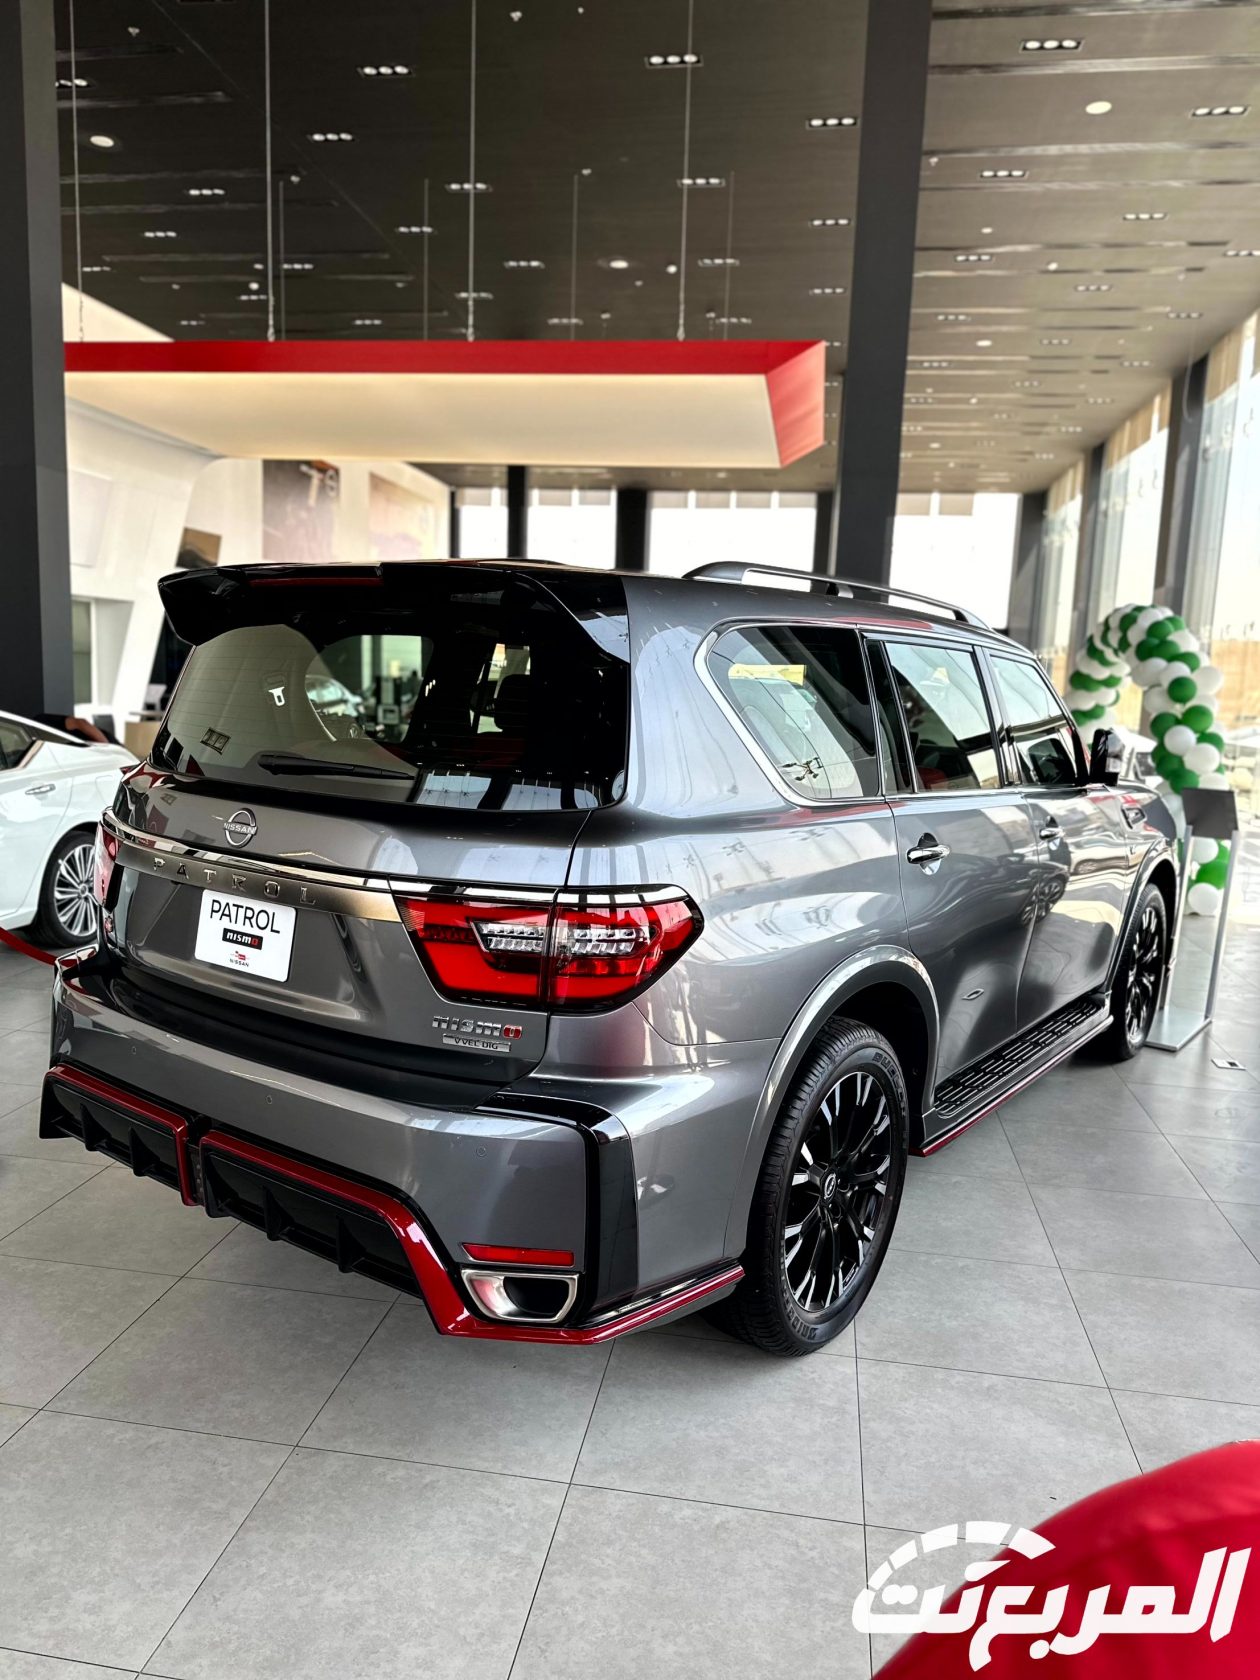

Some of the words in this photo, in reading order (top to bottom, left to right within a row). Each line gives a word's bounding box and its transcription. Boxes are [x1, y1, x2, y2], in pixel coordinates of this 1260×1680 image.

[223, 822, 257, 835] NISSAN
[153, 857, 316, 905] PATROL
[210, 899, 281, 934] PATROL
[229, 958, 250, 968] NISSAN
[482, 1039, 498, 1050] DIG
